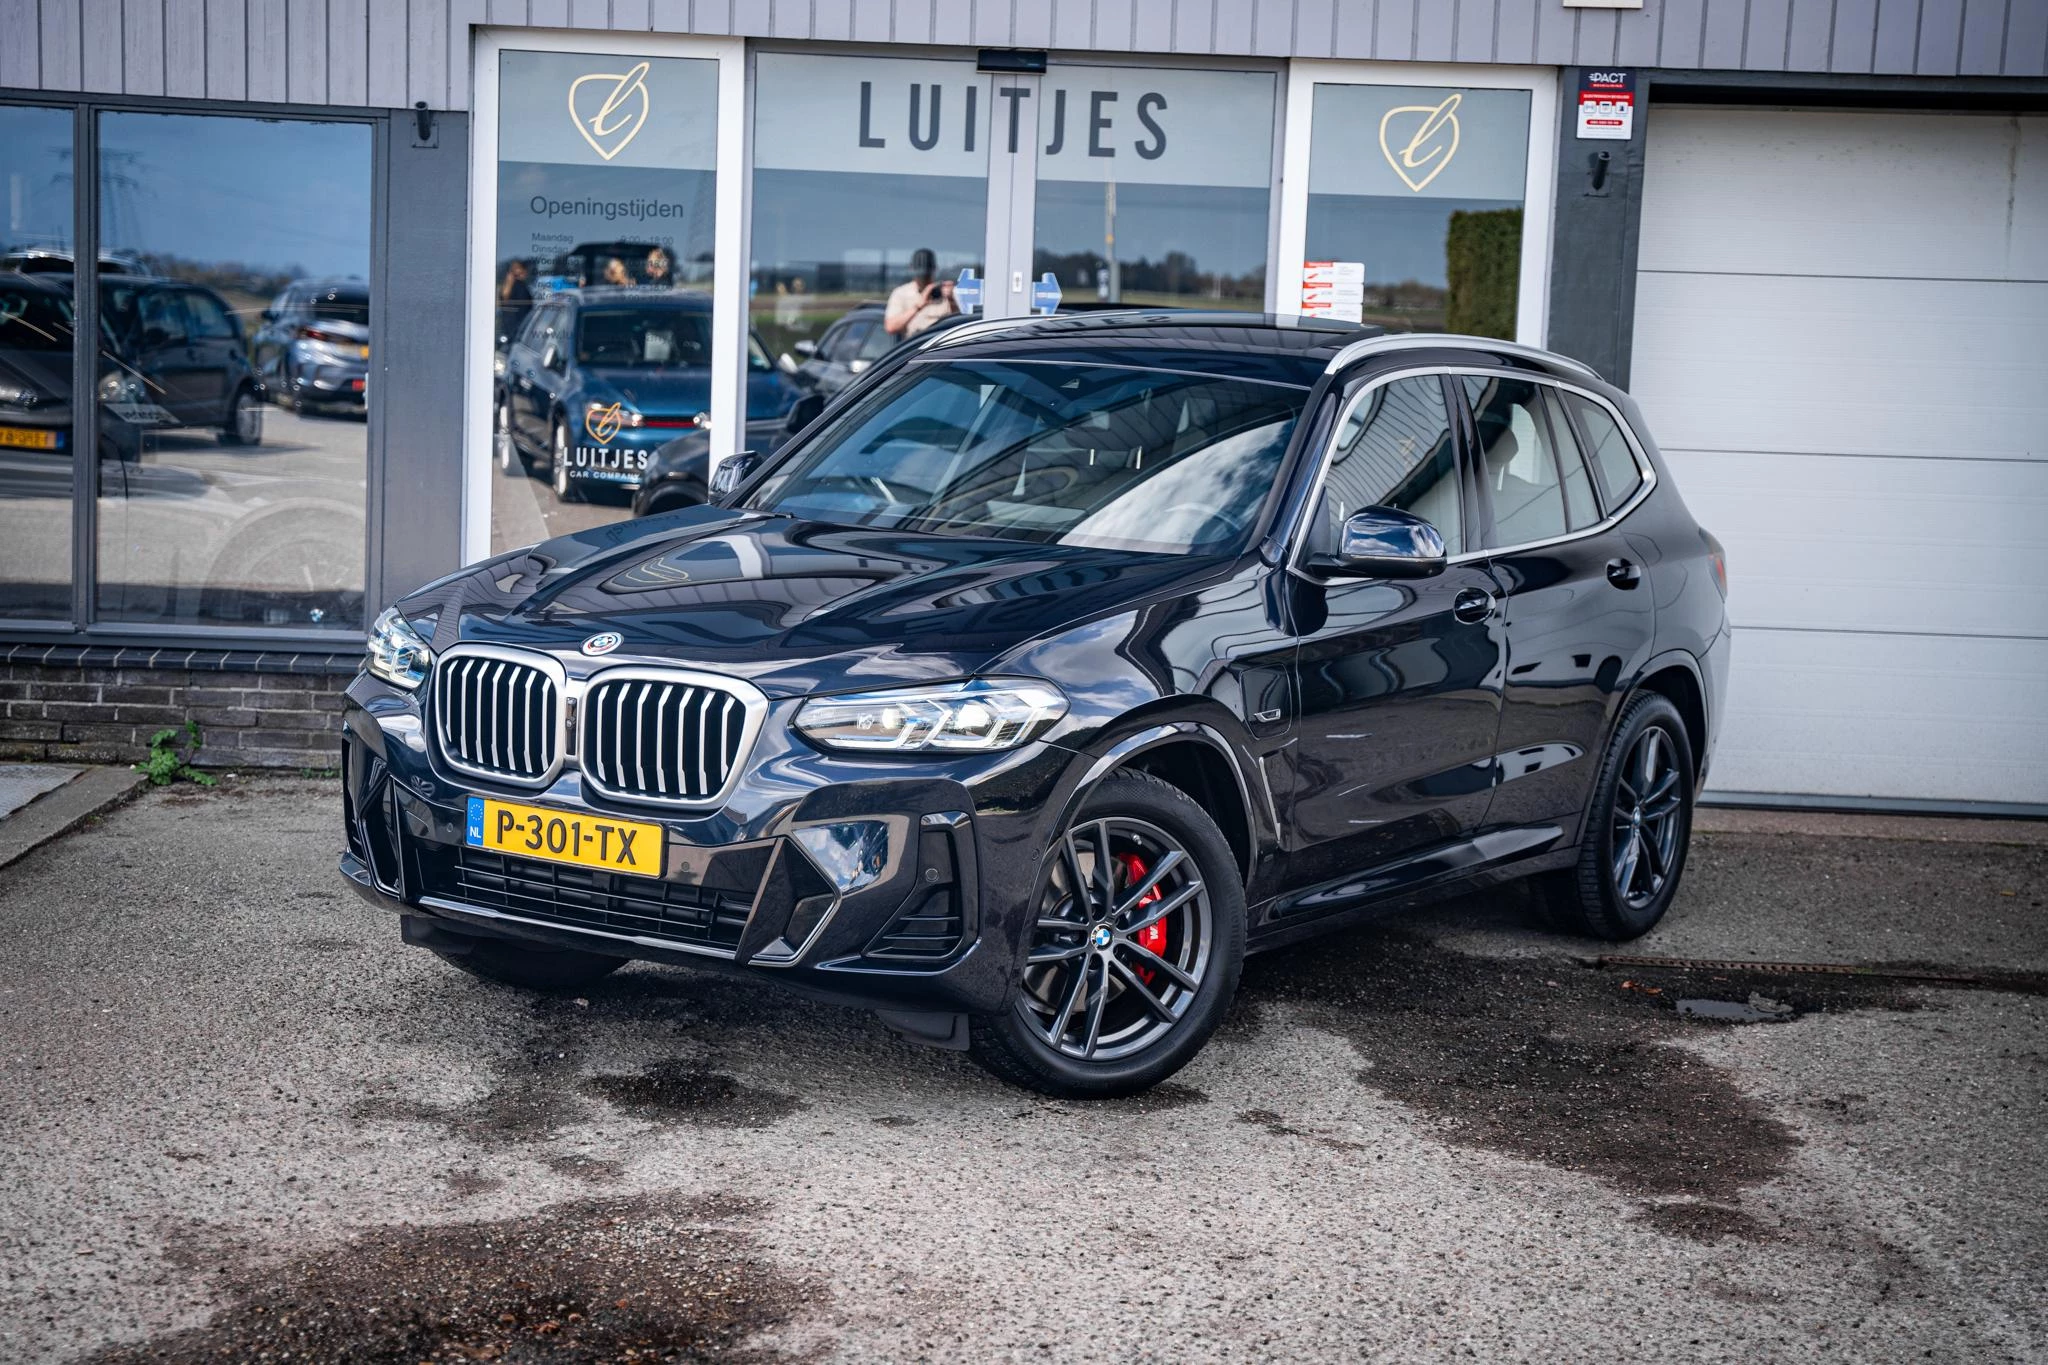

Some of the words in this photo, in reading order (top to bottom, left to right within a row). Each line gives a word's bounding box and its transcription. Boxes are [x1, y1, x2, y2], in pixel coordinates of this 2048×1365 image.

[1590, 72, 1627, 83] PACT
[859, 81, 1168, 160] LUITJES
[530, 195, 683, 221] Openingstijden
[531, 232, 574, 244] Maandag
[563, 446, 649, 470] LUITJES
[569, 470, 589, 479] CAR
[593, 471, 640, 480] COMPANY
[469, 825, 482, 839] NL
[496, 809, 637, 866] P-301-TX
